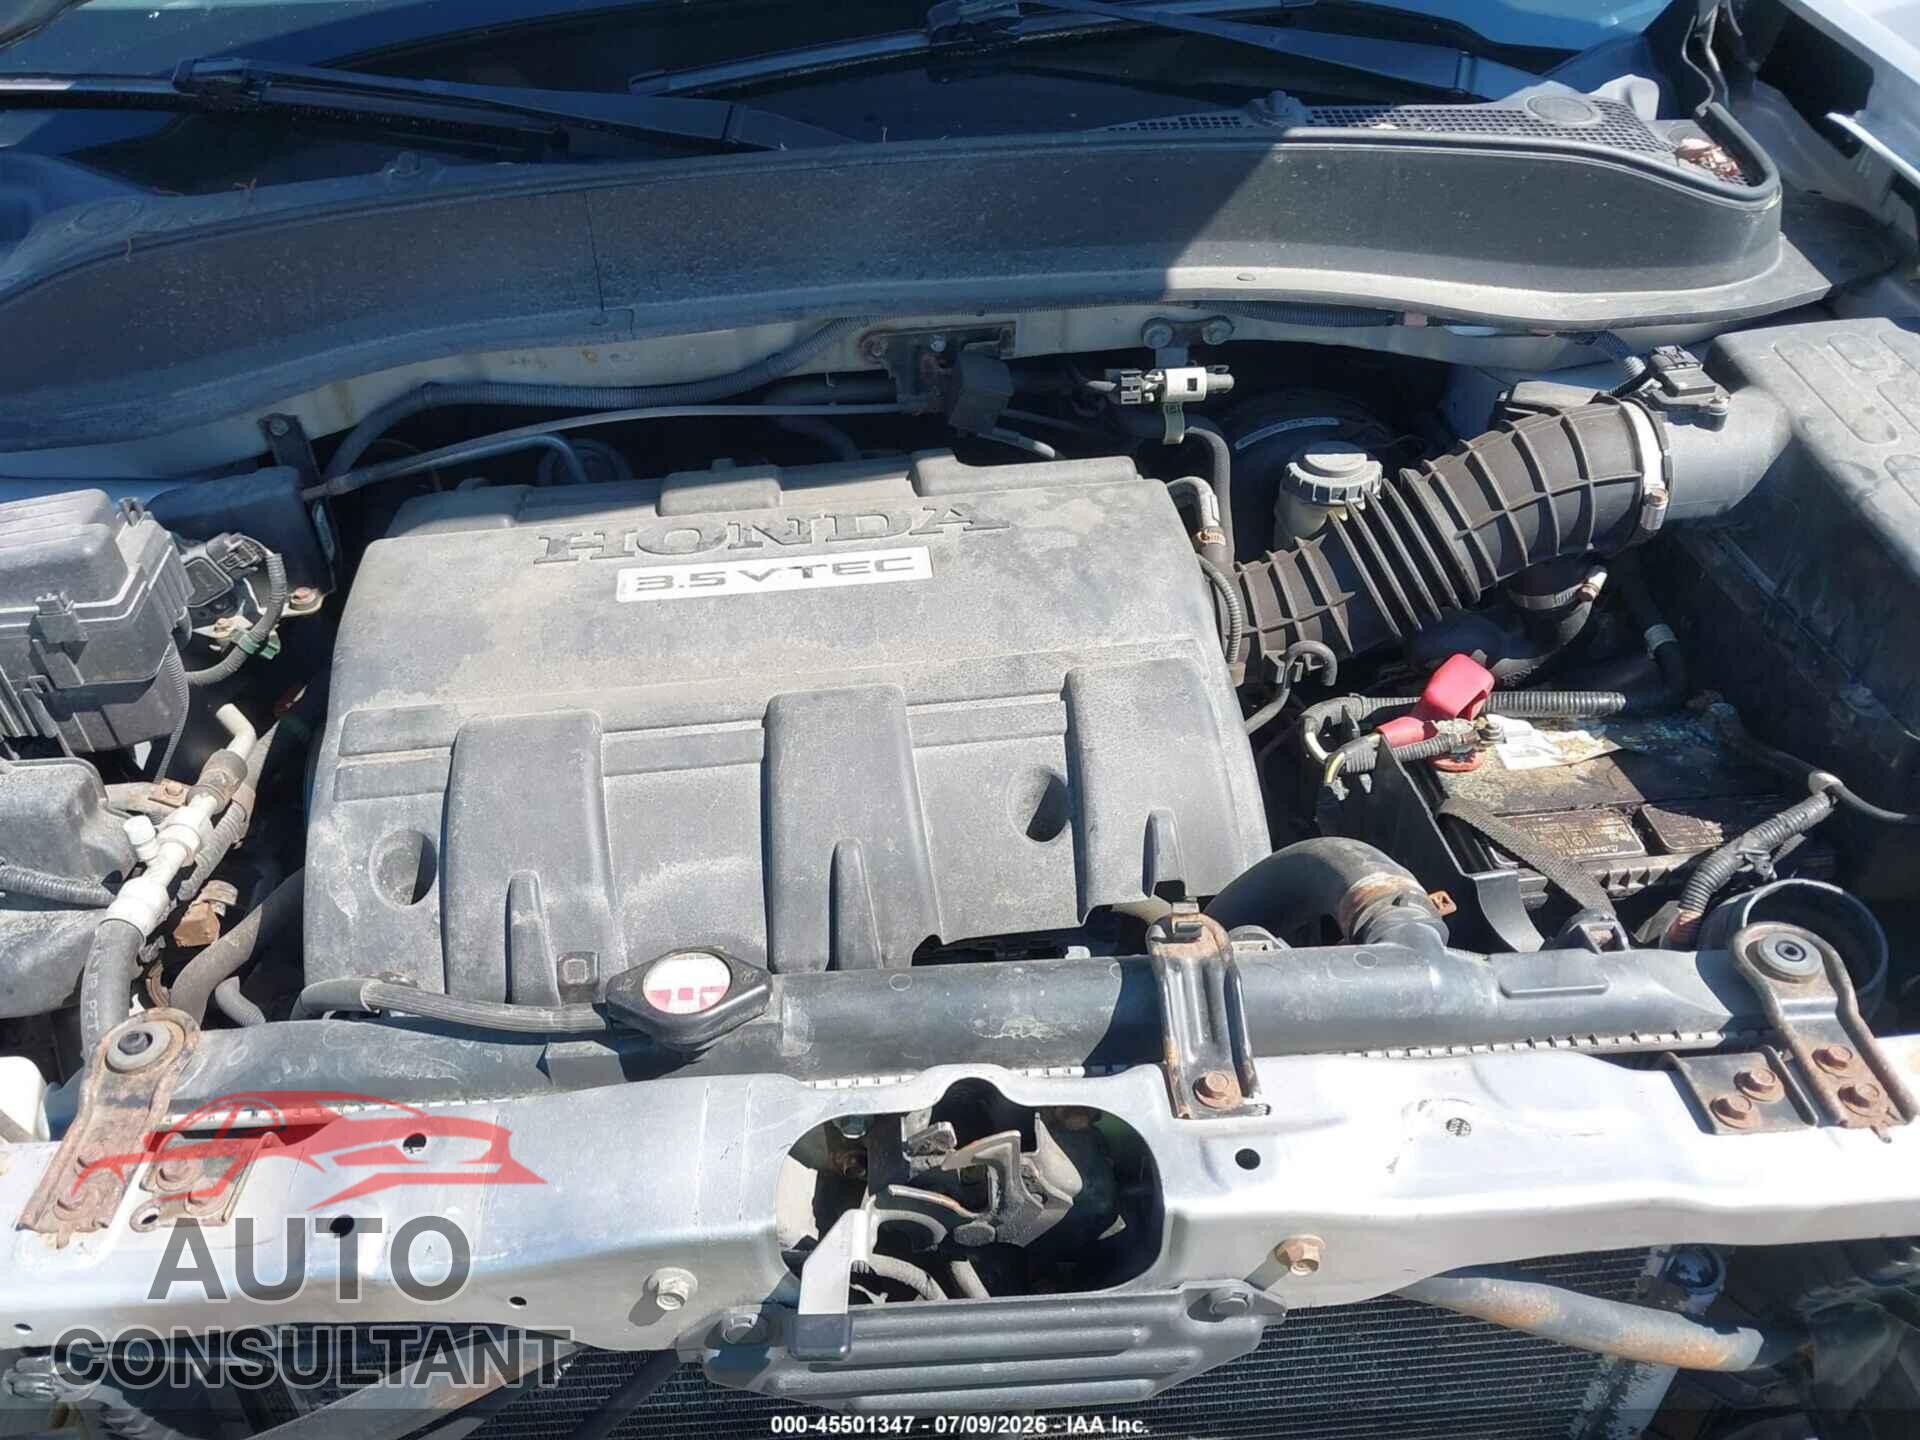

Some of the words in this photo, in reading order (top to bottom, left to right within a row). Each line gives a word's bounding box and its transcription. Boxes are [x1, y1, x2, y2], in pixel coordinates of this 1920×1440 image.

[534, 506, 1009, 564] HONDA
[635, 570, 727, 592] 3.5
[738, 556, 916, 583] VTEC
